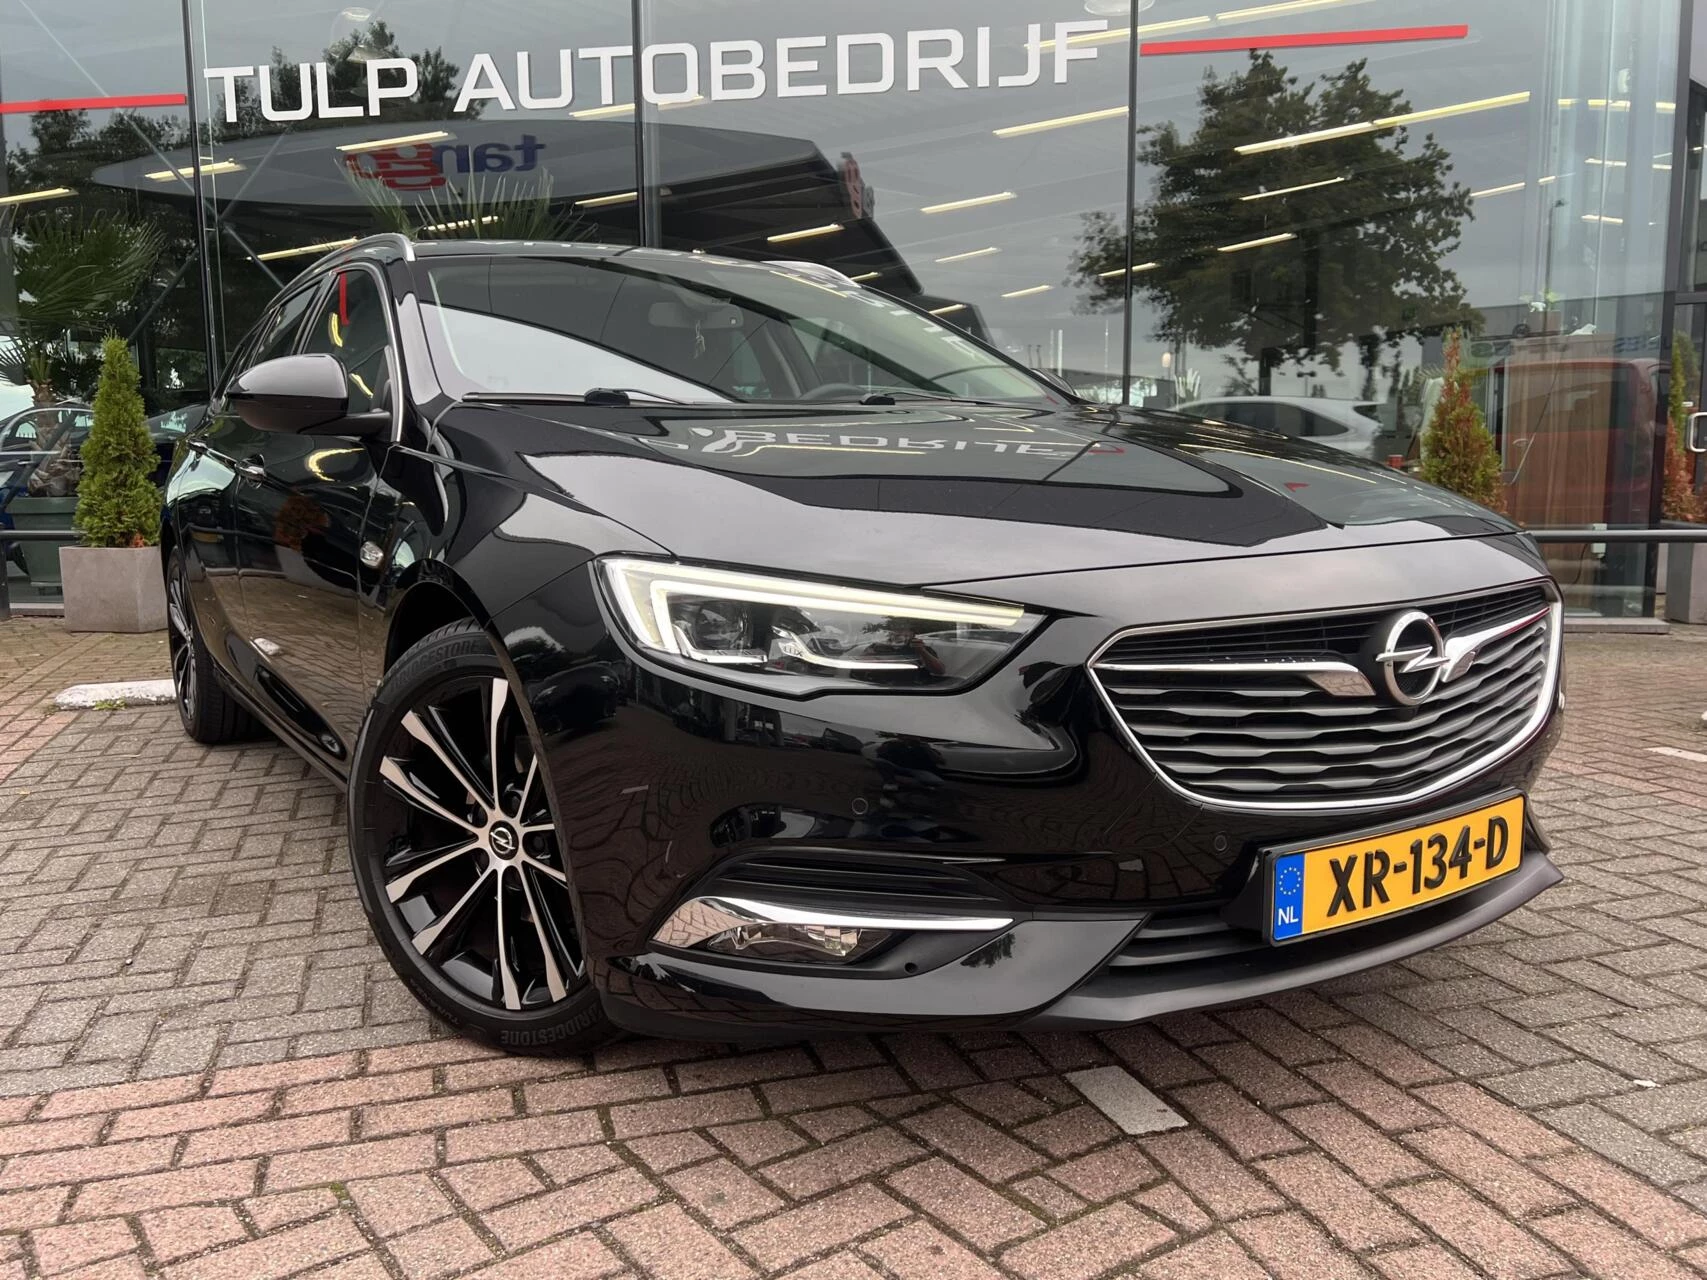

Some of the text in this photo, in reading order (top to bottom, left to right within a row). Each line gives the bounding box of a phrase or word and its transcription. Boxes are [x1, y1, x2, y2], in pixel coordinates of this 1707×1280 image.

[204, 19, 1108, 123] TULP AUTOBEDRIJF
[1278, 906, 1299, 926] NL
[1326, 815, 1509, 917] XR-134-D
